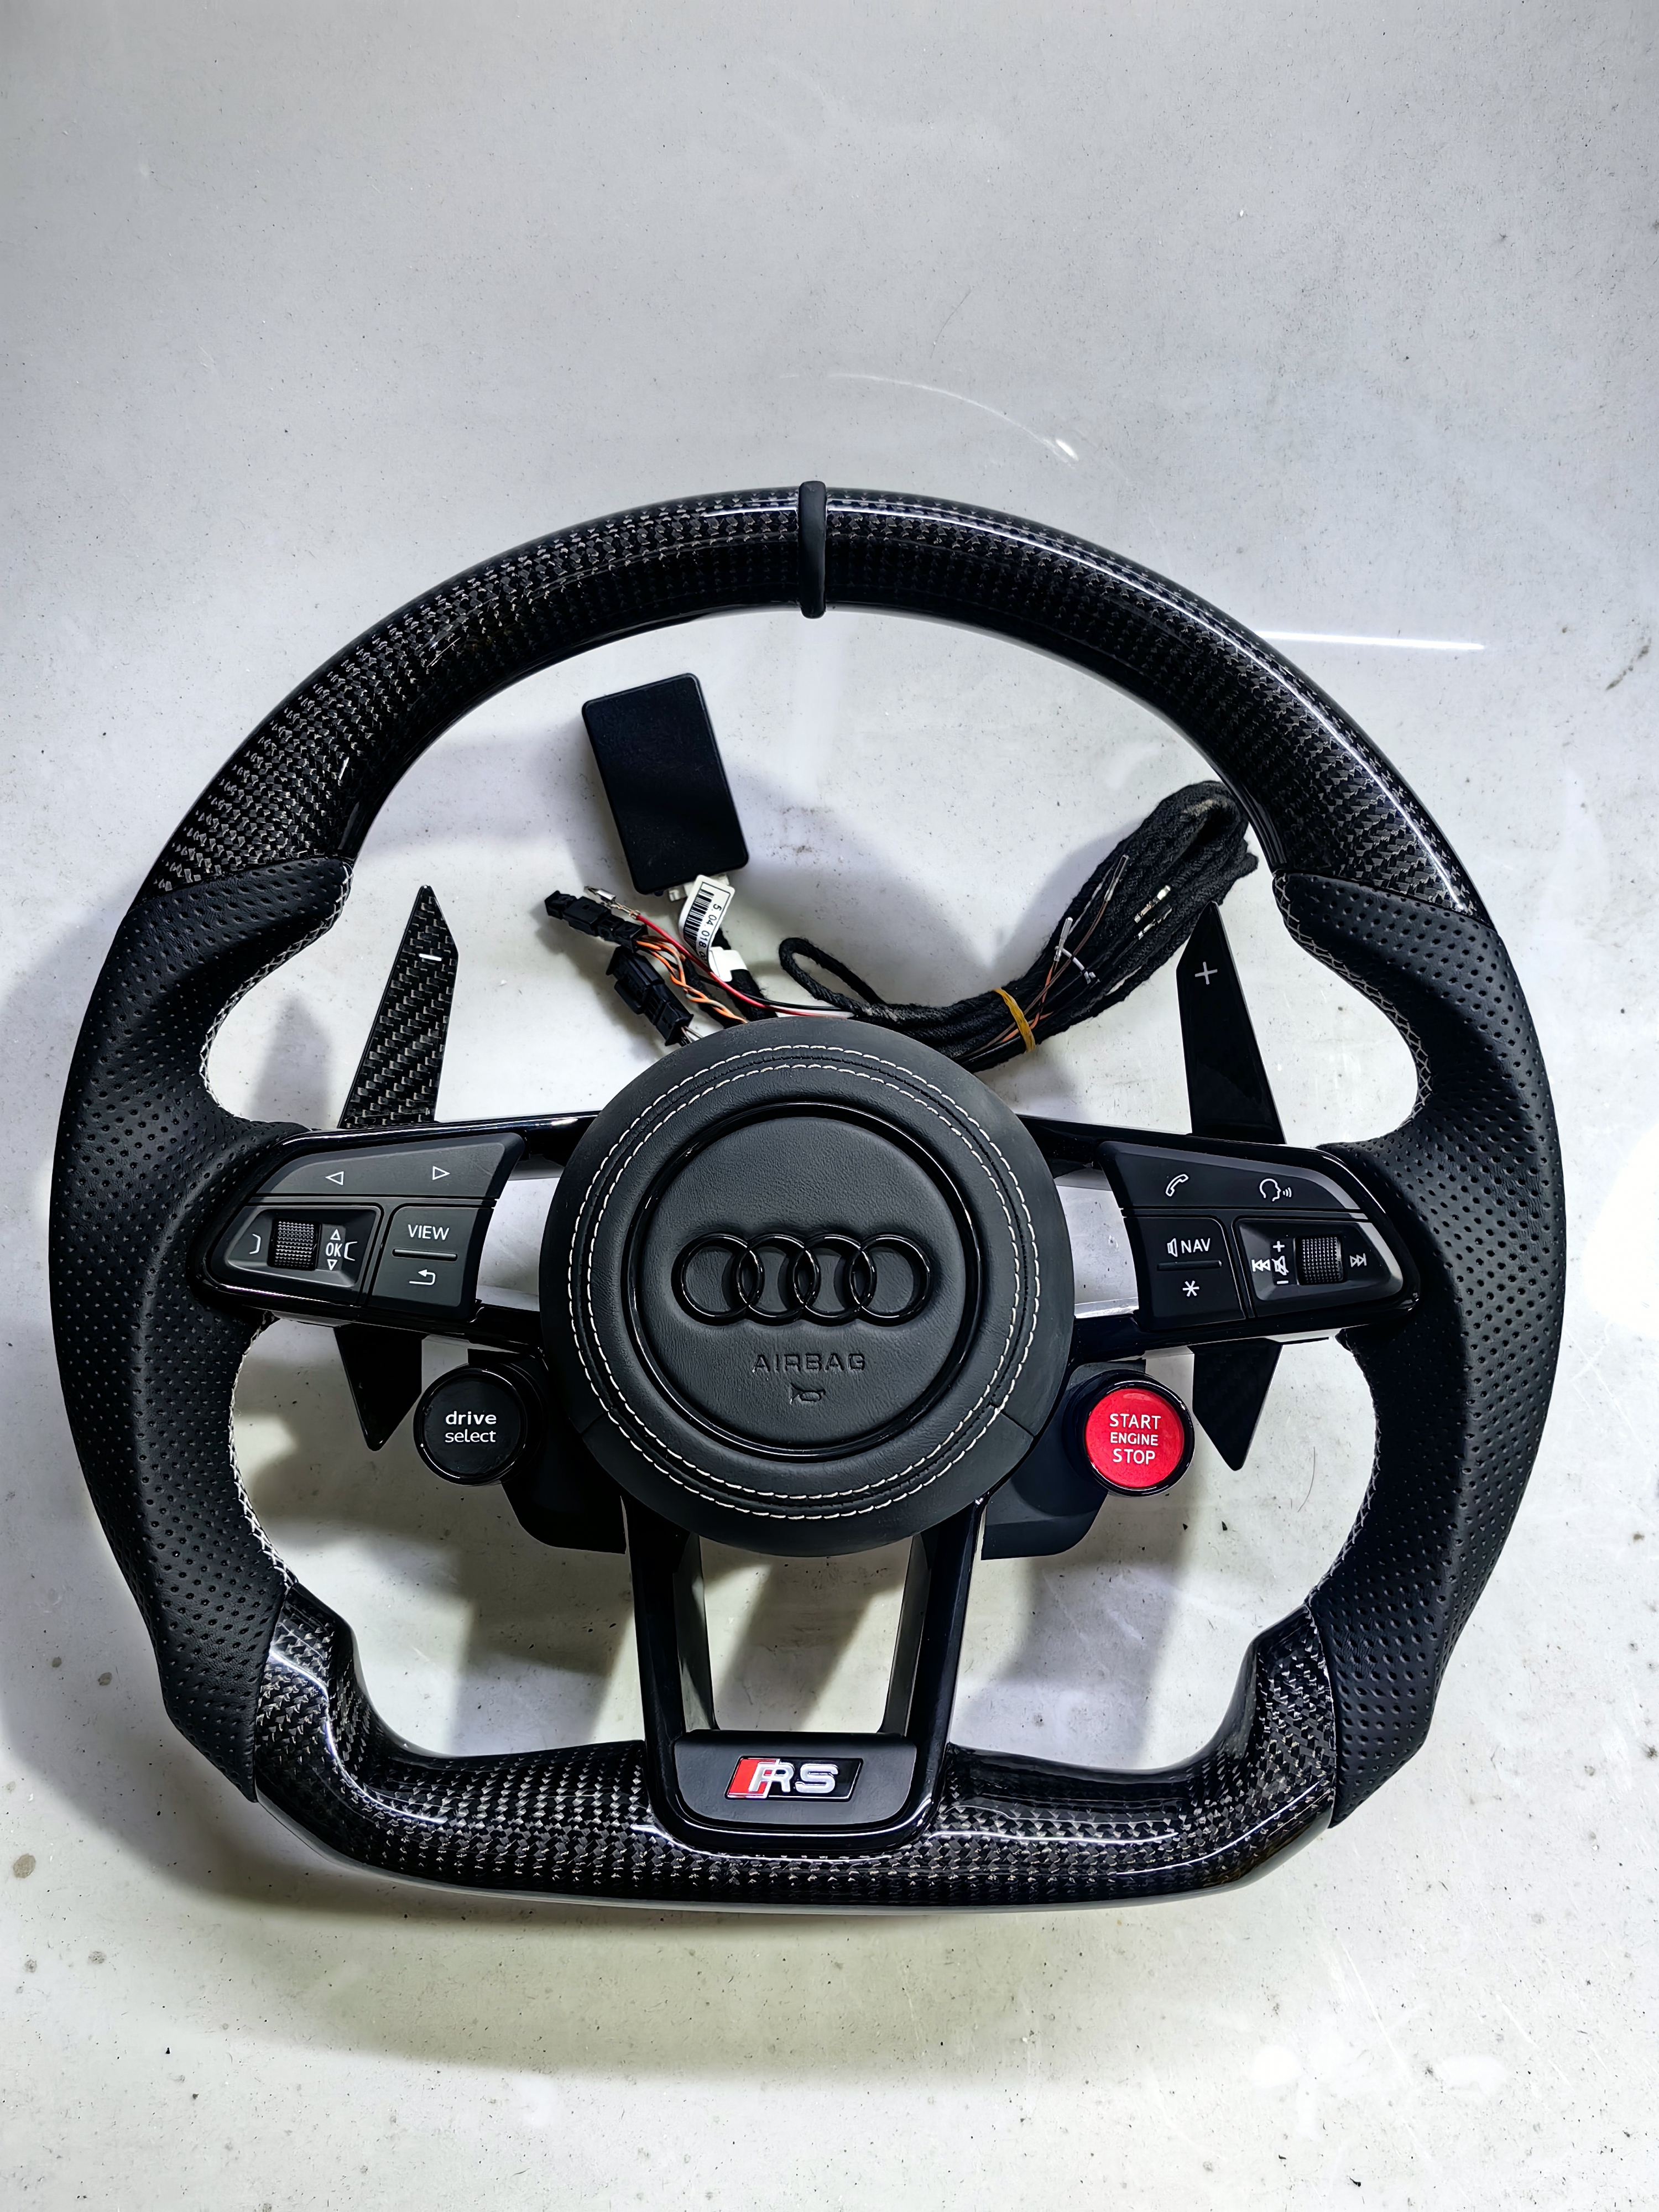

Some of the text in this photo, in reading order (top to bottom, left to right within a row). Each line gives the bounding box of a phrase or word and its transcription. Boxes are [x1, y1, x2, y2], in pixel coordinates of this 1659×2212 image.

[408, 1224, 450, 1241] VIEW
[326, 1242, 343, 1257] OK
[1181, 1238, 1211, 1254] NAV
[752, 1353, 865, 1372] AIRBAG
[445, 1410, 497, 1425] drive
[1109, 1413, 1162, 1430] START
[445, 1428, 497, 1443] select
[1110, 1431, 1159, 1447] ENGINE
[1112, 1448, 1156, 1465] STOP
[748, 1761, 839, 1794] RS
